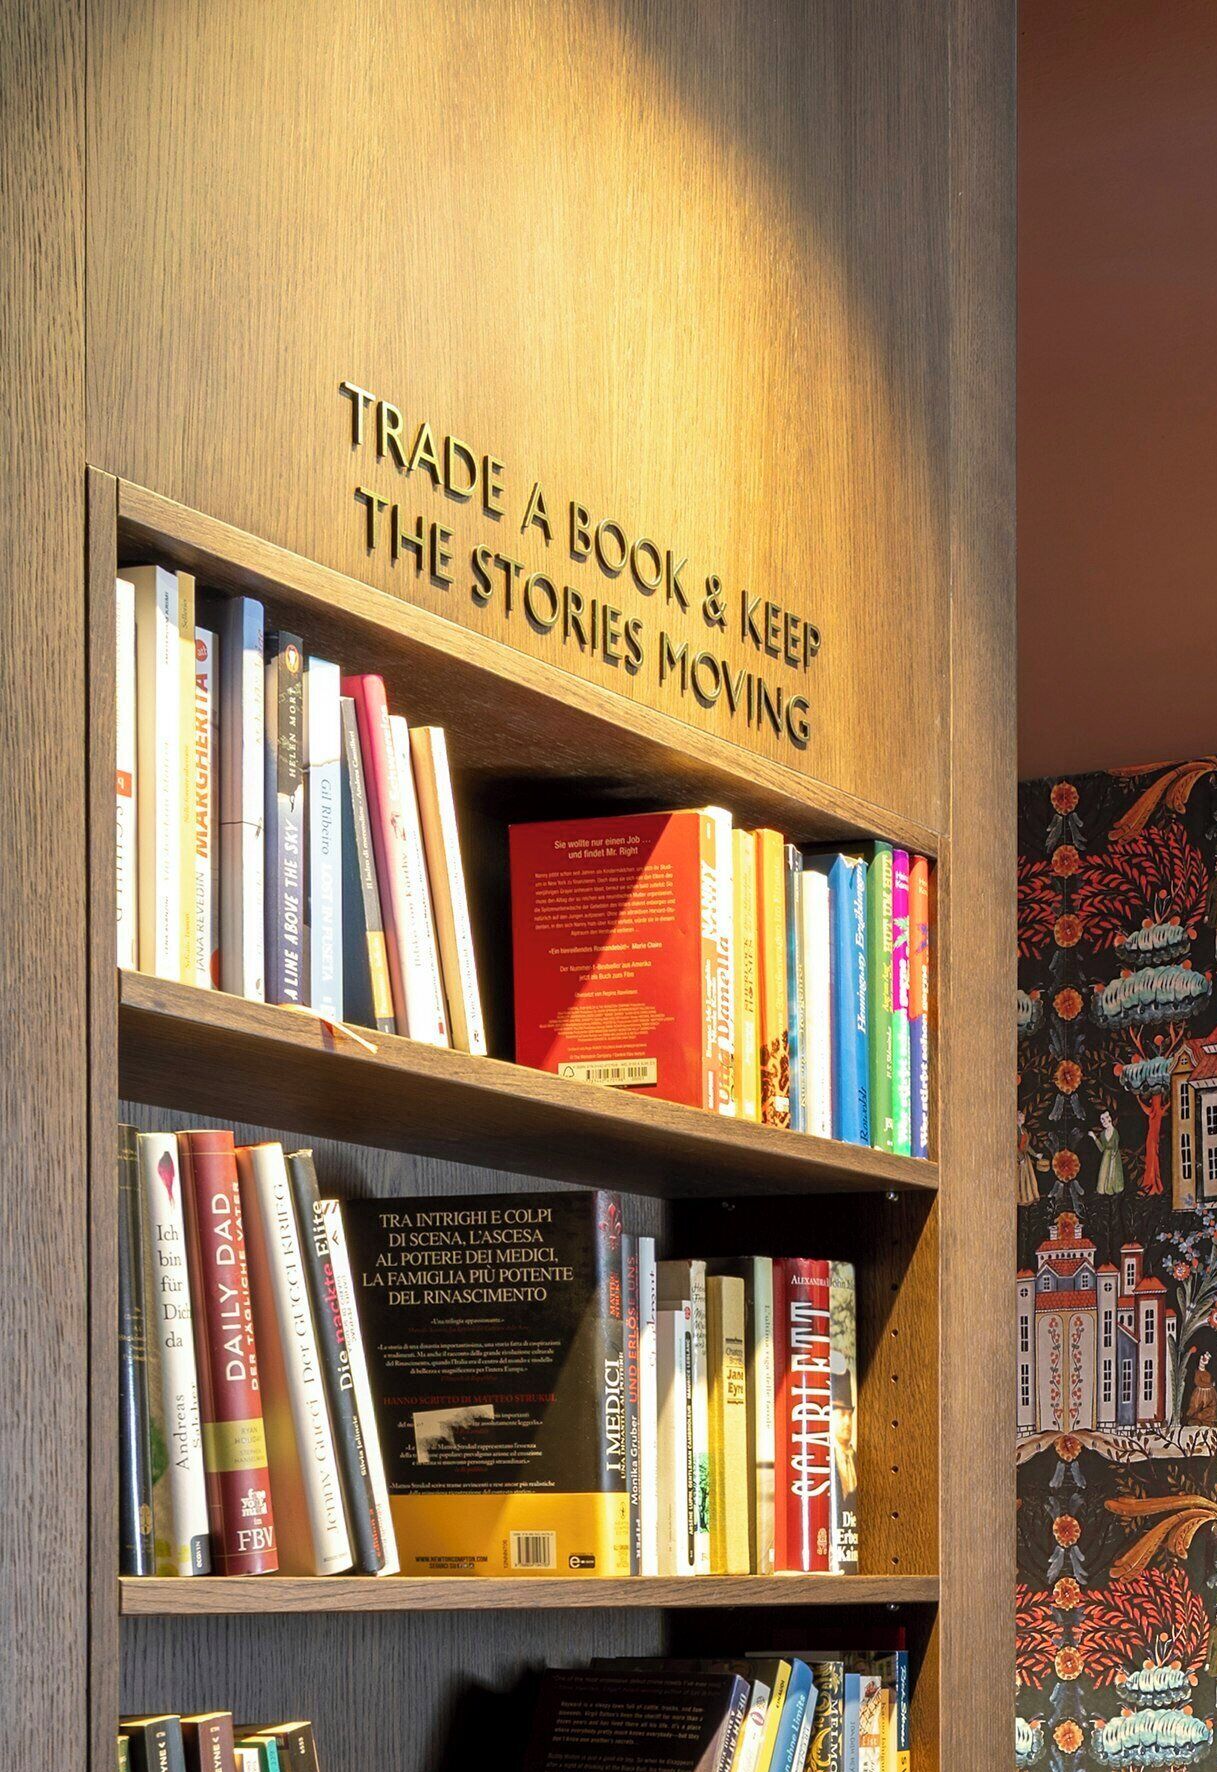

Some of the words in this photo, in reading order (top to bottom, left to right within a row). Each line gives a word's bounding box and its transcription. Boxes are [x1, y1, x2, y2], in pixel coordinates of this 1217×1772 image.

[340, 381, 505, 520] TRADE
[521, 481, 553, 543] A
[570, 500, 690, 610] BOOK
[703, 574, 728, 628] &
[742, 590, 821, 670] KEEP
[354, 486, 455, 586] THE
[472, 544, 644, 672] STORIES
[660, 631, 811, 746] MOVING
[287, 686, 297, 728] MORT
[288, 733, 297, 778] HELEN
[321, 778, 332, 801] Gil
[284, 818, 299, 855] SKY
[322, 807, 332, 855] Ribeiro
[555, 840, 567, 849] Sie
[568, 838, 590, 848] wollte
[605, 836, 626, 846] einen
[627, 835, 641, 845] Job
[568, 850, 582, 859] und
[584, 848, 605, 858] findet
[606, 847, 618, 856] Mr.
[619, 846, 638, 857] Right
[284, 858, 298, 887] THE
[882, 855, 892, 888] HUT
[284, 892, 299, 944] ABOVE
[882, 890, 892, 916] UM
[882, 918, 892, 951] HUT
[285, 949, 298, 986] LINE
[284, 988, 298, 1000] A
[211, 1193, 235, 1265] DAD
[232, 1182, 245, 1241] VATER
[312, 1200, 329, 1258] Elite
[379, 1214, 412, 1228] TRA
[416, 1211, 487, 1227] INTRIGHI
[491, 1210, 502, 1224] E
[504, 1208, 552, 1225] COLPI
[156, 1225, 179, 1242] Ich
[389, 1234, 405, 1247] DI
[409, 1232, 466, 1248] SCENA,
[469, 1229, 544, 1245] L'ASCESA
[158, 1250, 182, 1267] bin
[363, 1273, 384, 1287] LA
[388, 1270, 465, 1285] FAMIGLIA
[469, 1265, 495, 1283] PIÙ
[499, 1267, 574, 1283] POTENTE
[376, 1253, 397, 1267] AL
[401, 1251, 463, 1266] POTERE
[466, 1250, 492, 1264] DEI
[496, 1248, 559, 1264] MEDICI,
[626, 1256, 636, 1292] UNS
[161, 1275, 183, 1292] für
[239, 1251, 255, 1345] TÄGLICHE
[389, 1291, 420, 1305] DEL
[424, 1287, 547, 1304] RINASCIMENTO
[323, 1263, 346, 1344] nackte
[165, 1331, 183, 1348] da
[218, 1282, 247, 1381] DAILY
[626, 1299, 637, 1359] ERLÖSE
[249, 1354, 259, 1391] DER
[338, 1350, 354, 1392] Die
[628, 1365, 637, 1404] UND
[604, 1358, 621, 1456] MEDICI
[790, 1302, 831, 1498] SCARLETT
[172, 1394, 190, 1470] Andreas
[306, 1399, 326, 1462] Gucci
[630, 1415, 638, 1458] Gruber
[606, 1461, 621, 1471] I
[631, 1460, 639, 1505] Monika
[241, 1498, 265, 1510] your
[248, 1488, 267, 1500] free
[319, 1469, 339, 1533] Jenny
[842, 1511, 857, 1528] Die
[237, 1526, 274, 1551] FBV
[786, 1736, 798, 1768] ohne
[792, 1694, 806, 1735] Limits
